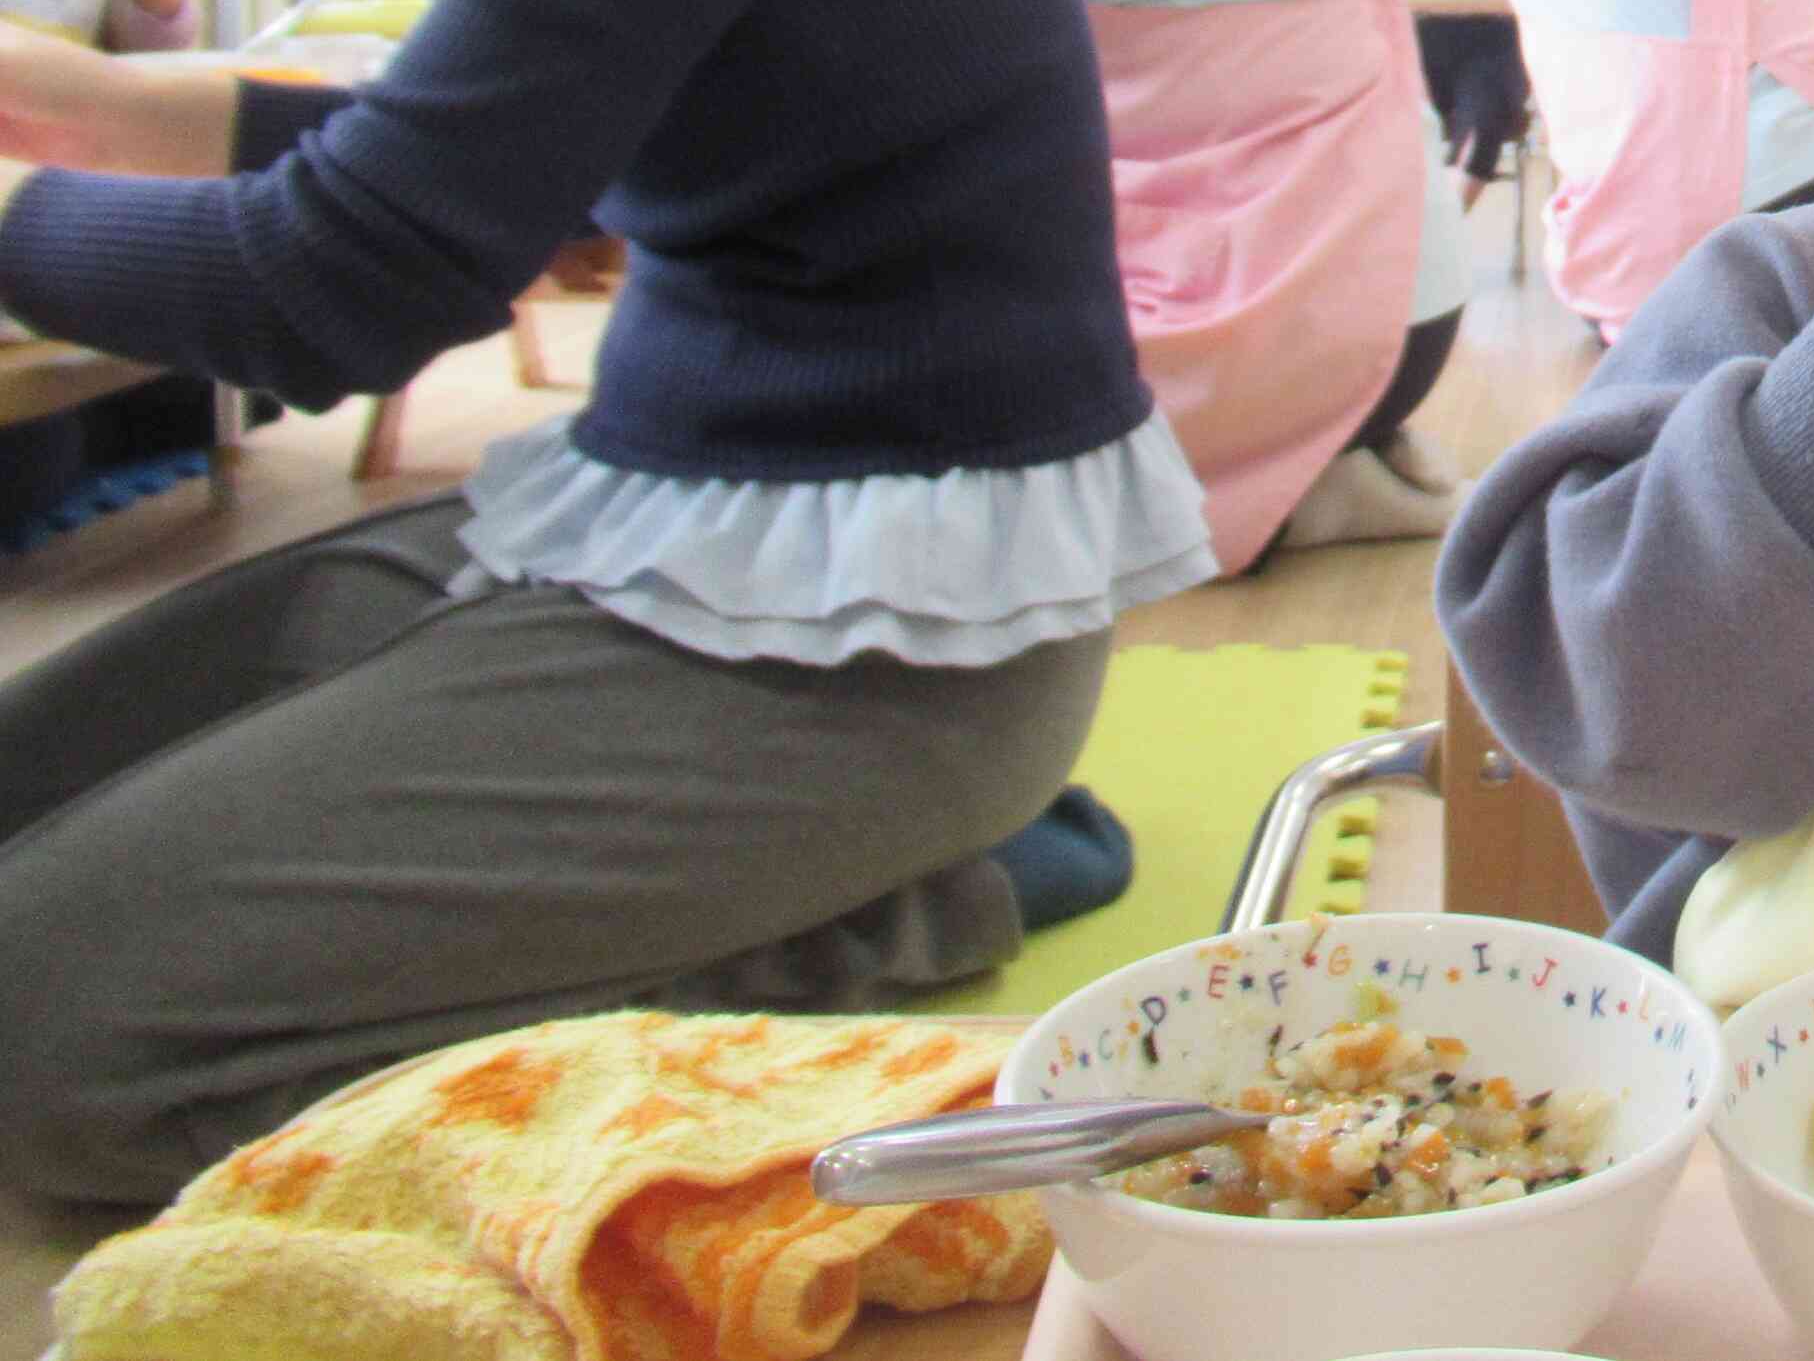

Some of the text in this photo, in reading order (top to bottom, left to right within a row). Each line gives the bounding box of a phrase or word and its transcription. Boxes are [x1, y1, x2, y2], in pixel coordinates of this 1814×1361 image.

[1207, 964, 1230, 999] E
[1268, 970, 1288, 1006] F
[1327, 943, 1352, 976] G
[1398, 958, 1430, 993] H
[1472, 942, 1492, 974] I
[1532, 957, 1559, 987] J
[1590, 987, 1607, 1017] K
[1766, 1025, 1788, 1065] X
